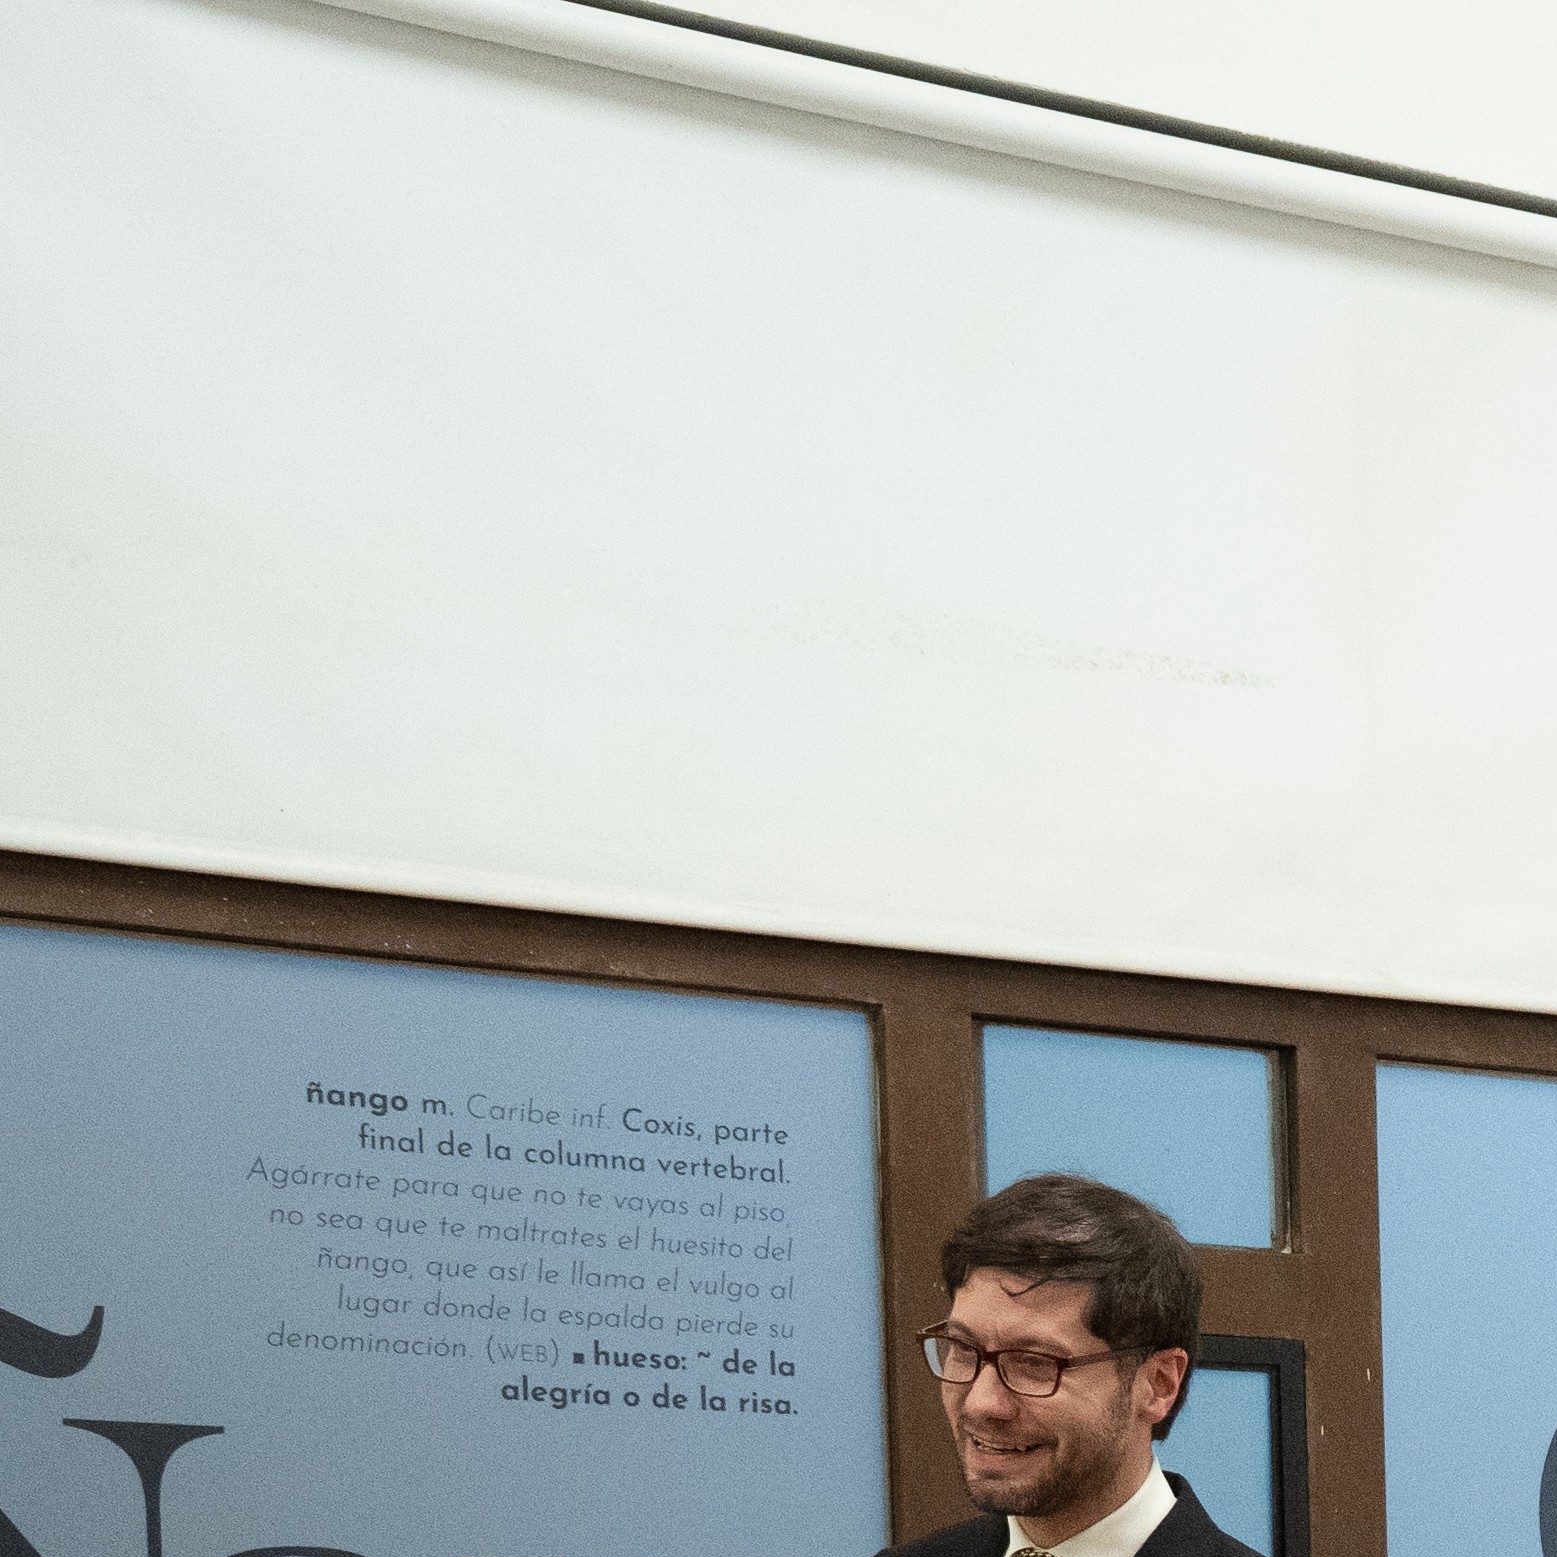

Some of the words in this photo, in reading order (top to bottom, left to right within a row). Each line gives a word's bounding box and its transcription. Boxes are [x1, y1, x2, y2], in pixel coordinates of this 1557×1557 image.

[306, 1083, 408, 1116] ñango
[422, 1098, 453, 1117] m.
[467, 1096, 559, 1126] Caribe
[573, 1106, 611, 1130] inf.
[622, 1108, 702, 1141] Coxis,
[715, 1118, 789, 1147] parte
[359, 1124, 424, 1155] final
[437, 1135, 473, 1158] de
[485, 1136, 512, 1161] la
[524, 1141, 646, 1173] columna
[657, 1152, 791, 1185] vertebral.
[246, 1157, 381, 1189] Agárrate
[393, 1177, 460, 1199] para
[472, 1183, 522, 1203] que
[533, 1186, 567, 1206] no
[579, 1187, 603, 1209] te
[615, 1194, 689, 1218] vayas
[699, 1194, 724, 1218] al
[735, 1201, 793, 1227] piso,
[270, 1206, 303, 1227] no
[317, 1210, 363, 1231] sea
[376, 1216, 426, 1239] que
[440, 1215, 466, 1237] te
[478, 1219, 607, 1249] maltrates
[618, 1229, 638, 1251] el
[651, 1229, 742, 1259] huesito
[754, 1236, 793, 1263] del
[317, 1248, 413, 1280] ñango,
[426, 1260, 477, 1282] que
[489, 1262, 528, 1282] así
[538, 1259, 558, 1285] le
[572, 1263, 645, 1292] llama
[657, 1271, 678, 1293] el
[690, 1276, 759, 1303] vulgo
[771, 1278, 794, 1301] al
[338, 1285, 413, 1318] lugar
[423, 1294, 510, 1322] donde
[523, 1296, 547, 1323] la
[558, 1302, 664, 1331] espalda
[677, 1314, 758, 1338] pierde
[769, 1321, 795, 1340] su
[267, 1323, 474, 1359] denominación.
[487, 1337, 558, 1364] (WEB)
[593, 1340, 687, 1371] hueso:
[723, 1351, 757, 1375] de
[769, 1352, 796, 1377] la
[501, 1376, 611, 1410] alegría
[623, 1389, 640, 1408] o
[651, 1384, 688, 1410] de
[700, 1386, 727, 1413] la
[739, 1391, 799, 1416] risa.
